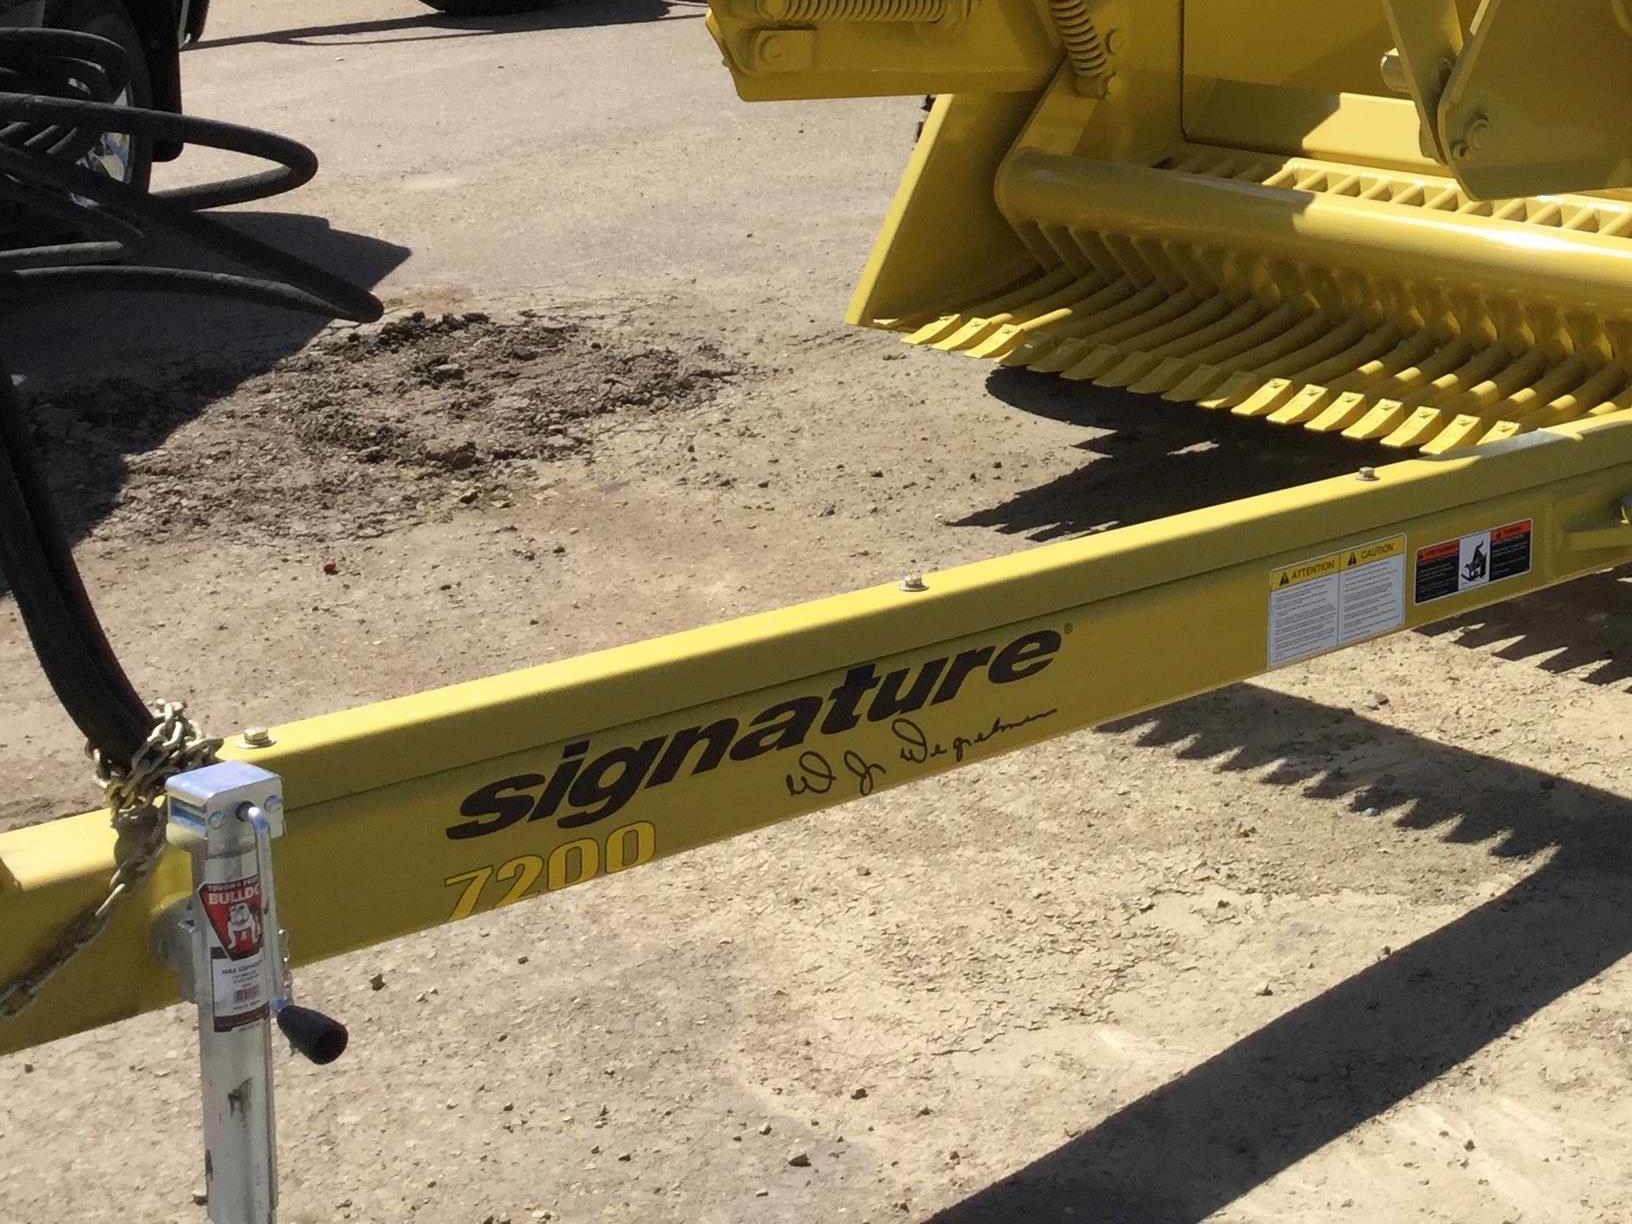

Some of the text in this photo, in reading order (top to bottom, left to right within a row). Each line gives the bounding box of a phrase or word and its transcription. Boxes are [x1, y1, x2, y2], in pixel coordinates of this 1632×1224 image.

[1360, 543, 1395, 560] CAUTION
[1292, 560, 1335, 579] ATTENTION
[445, 629, 1063, 840] signature
[444, 819, 656, 924] 7200
[208, 882, 260, 905] BULLDO
